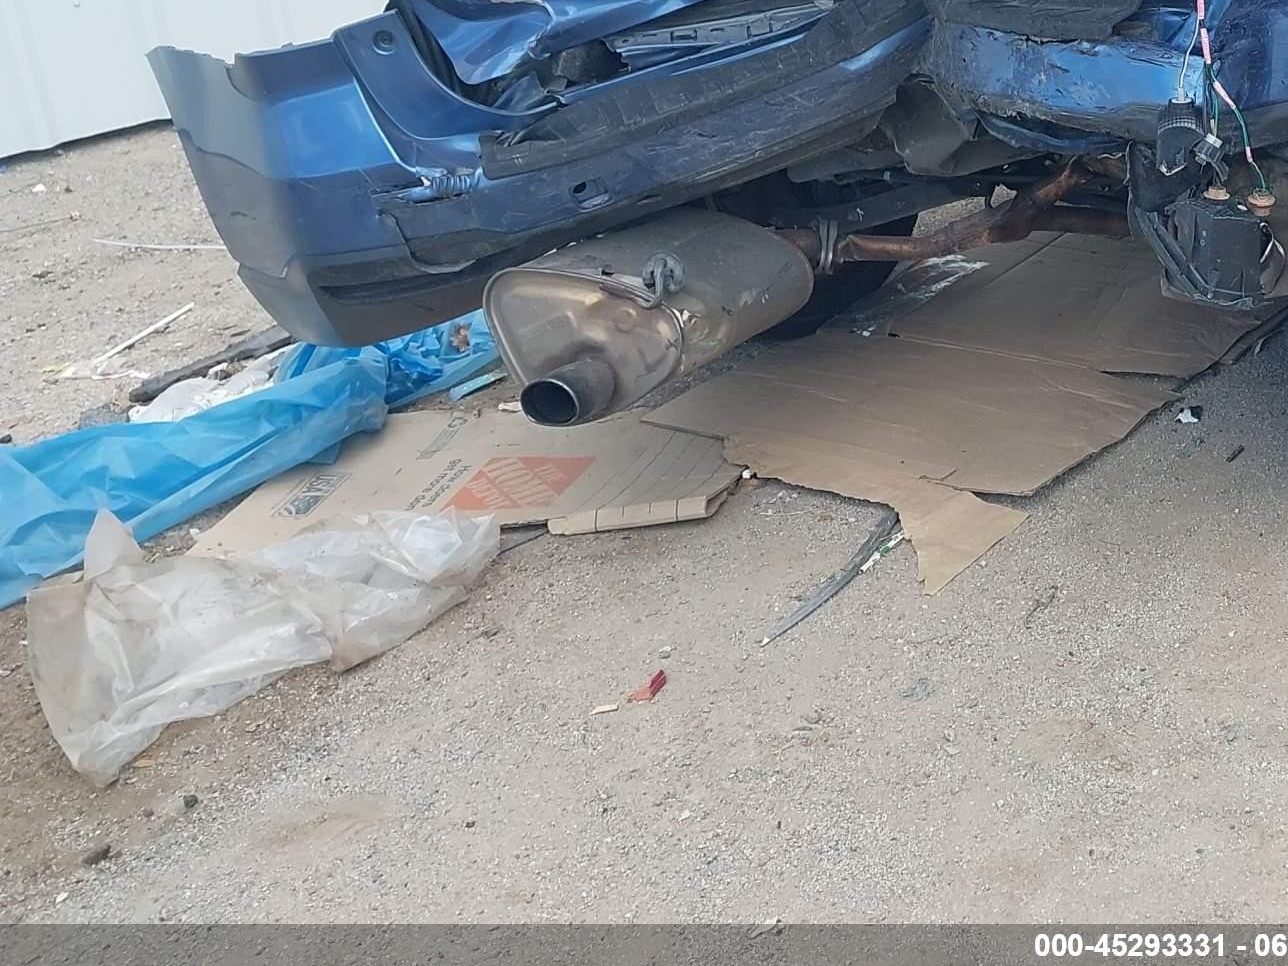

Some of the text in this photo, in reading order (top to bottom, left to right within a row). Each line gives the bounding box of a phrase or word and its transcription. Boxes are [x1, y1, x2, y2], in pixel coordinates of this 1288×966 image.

[301, 474, 338, 494] USA
[481, 457, 557, 507] HOME
[533, 464, 568, 480] THE
[465, 478, 513, 509] DEPOT
